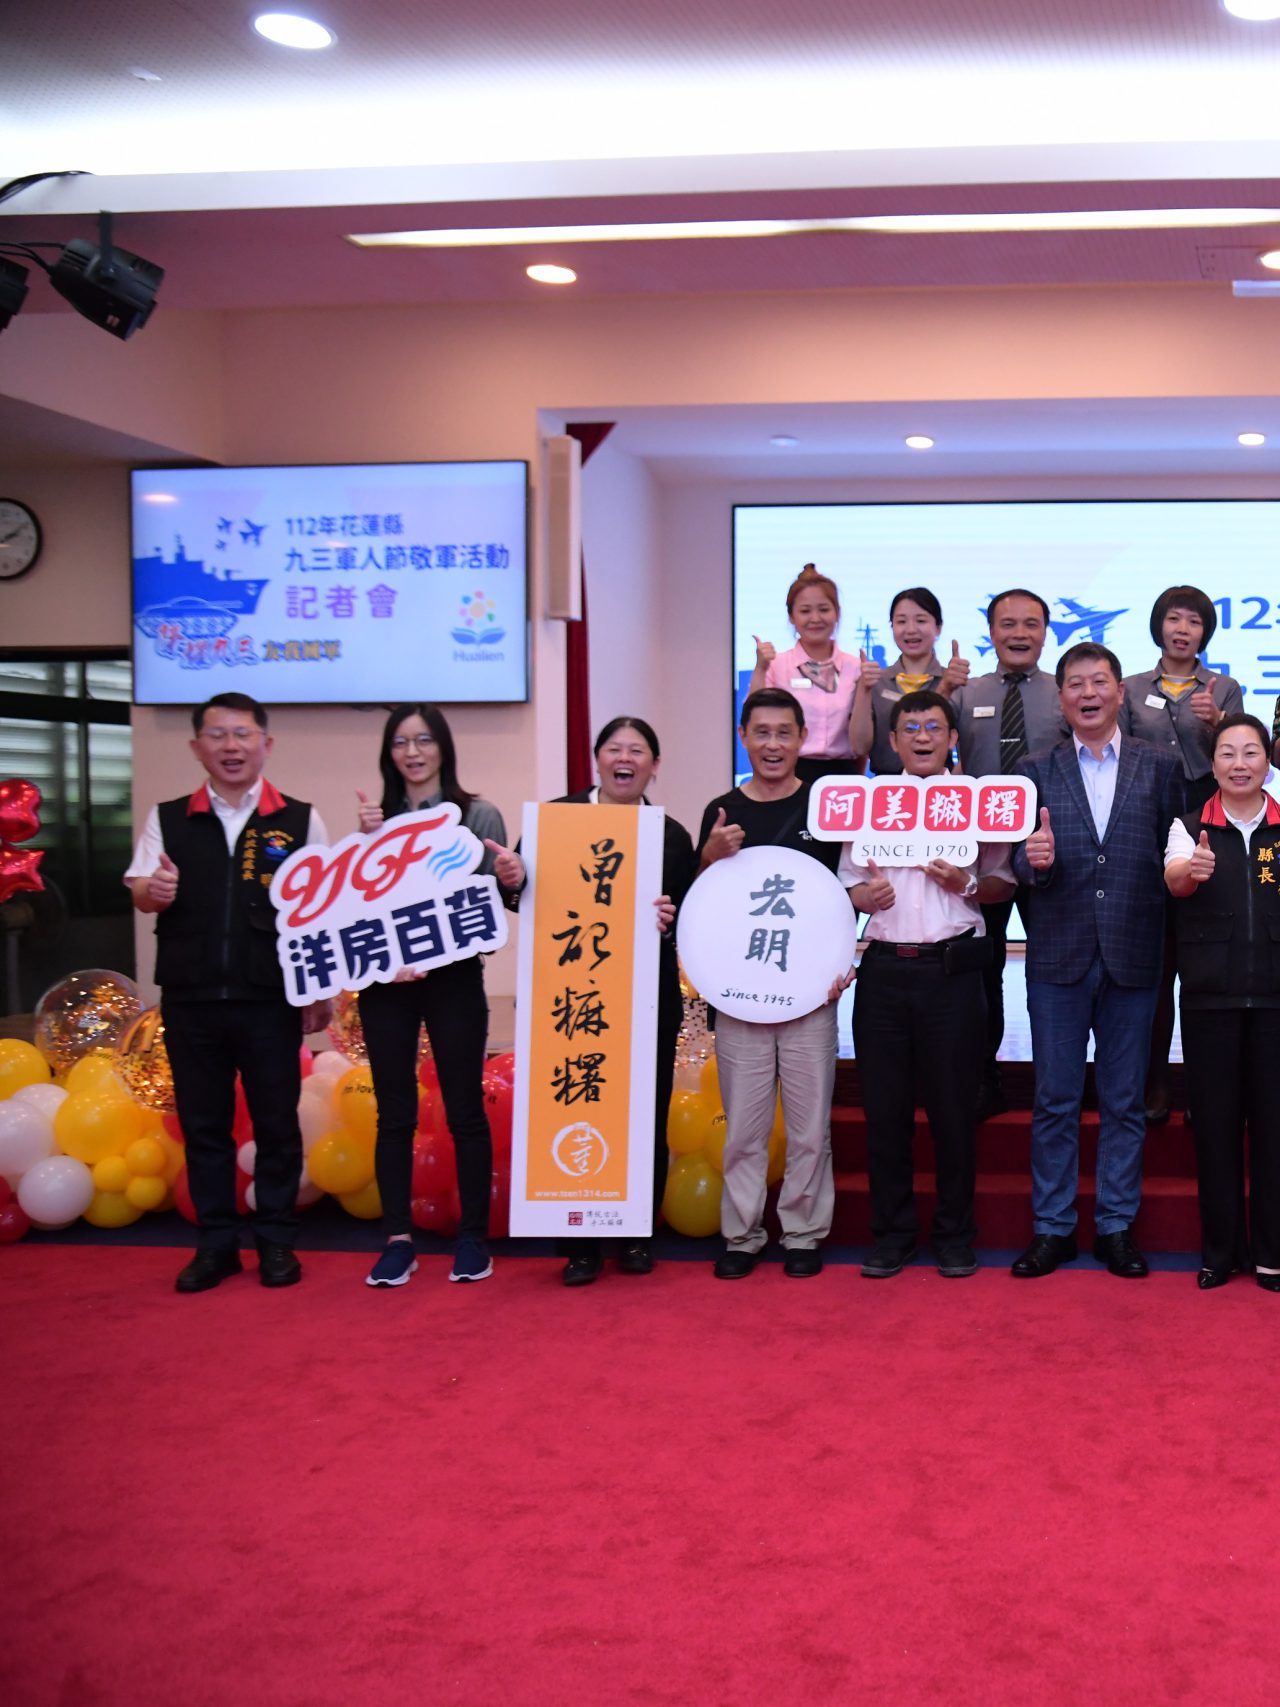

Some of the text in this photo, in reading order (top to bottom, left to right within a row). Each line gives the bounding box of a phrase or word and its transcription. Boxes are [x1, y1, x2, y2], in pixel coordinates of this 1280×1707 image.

[284, 512, 404, 537] 112年花蓮縣
[284, 543, 510, 572] 九三軍人節敬軍活動
[285, 583, 398, 620] 記者會
[453, 649, 505, 662] Hualien
[861, 844, 968, 858] SINCE 1970
[1257, 847, 1276, 884] 縣長
[745, 873, 796, 972] 宏明
[288, 886, 498, 995] 洋房百貨
[721, 988, 760, 1003] Since
